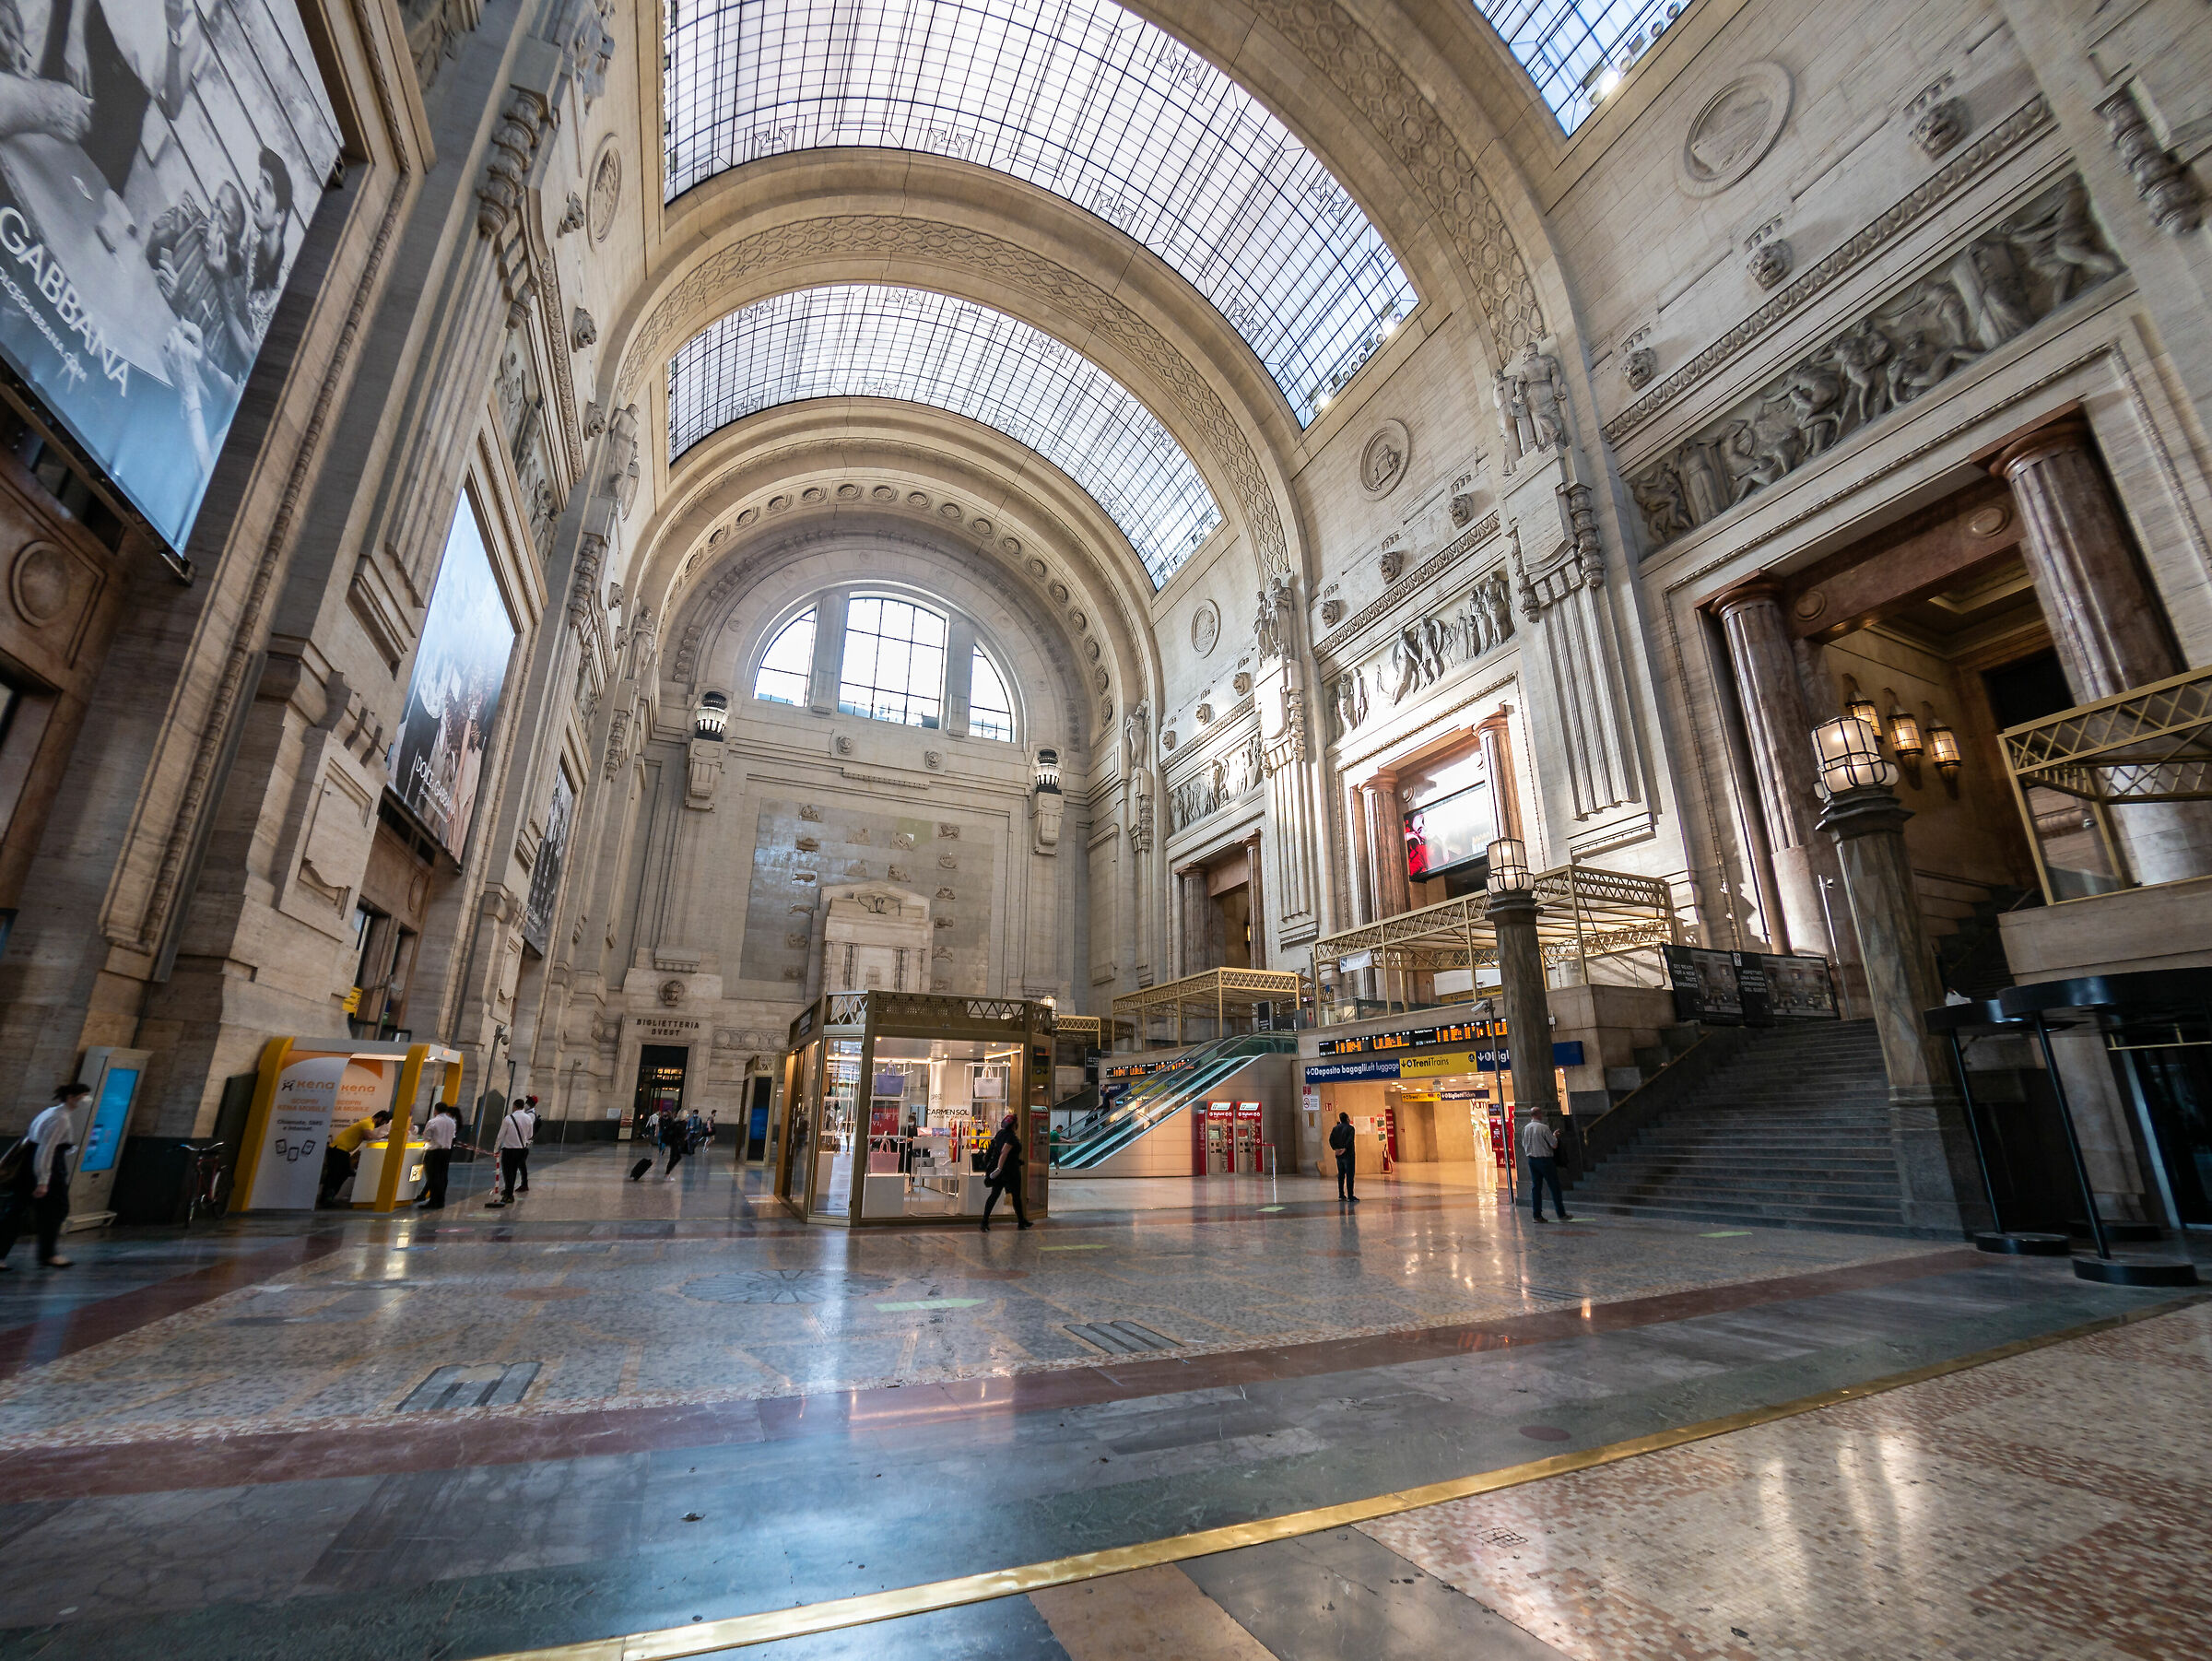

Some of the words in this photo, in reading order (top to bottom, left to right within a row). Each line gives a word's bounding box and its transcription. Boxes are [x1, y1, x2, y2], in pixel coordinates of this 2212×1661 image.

[0, 206, 130, 397] GABBANA
[636, 1019, 700, 1030] BIGLIETTERIA
[651, 1028, 680, 1037] OVEST
[1412, 1057, 1430, 1068] Treni
[1430, 1056, 1449, 1066] Trains
[1315, 1066, 1341, 1077] Deposito
[1341, 1063, 1367, 1075] bagagli
[1366, 1062, 1375, 1072] Left
[1375, 1061, 1399, 1073] luggage
